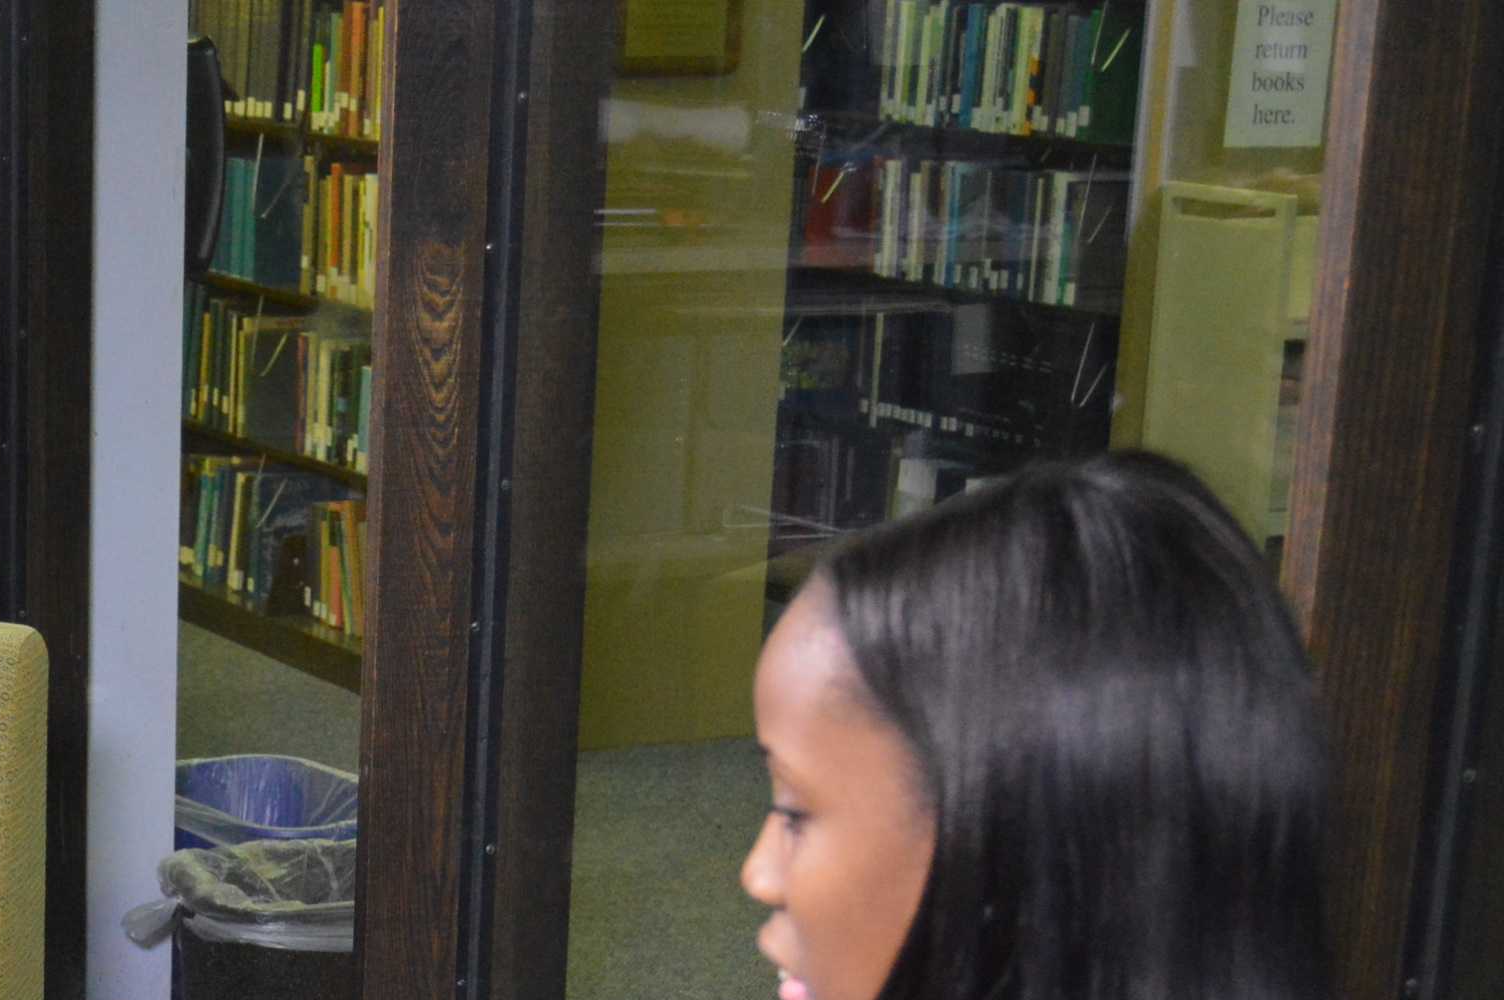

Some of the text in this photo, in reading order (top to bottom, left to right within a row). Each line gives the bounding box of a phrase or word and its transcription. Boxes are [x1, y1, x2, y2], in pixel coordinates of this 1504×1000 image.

[1257, 4, 1314, 27] Please
[1255, 42, 1309, 60] return
[1251, 71, 1305, 92] books
[1252, 103, 1296, 125] here.
